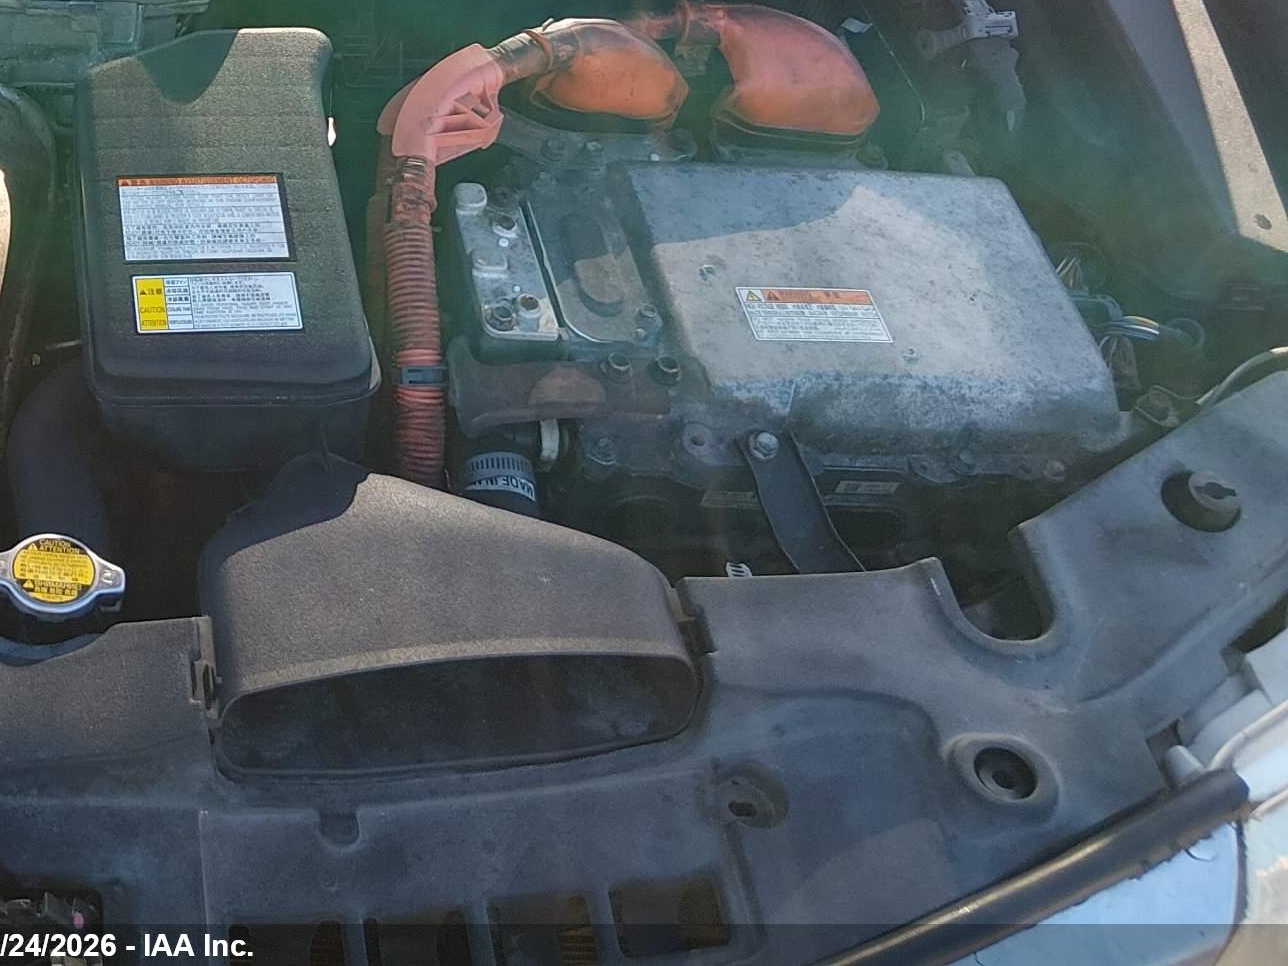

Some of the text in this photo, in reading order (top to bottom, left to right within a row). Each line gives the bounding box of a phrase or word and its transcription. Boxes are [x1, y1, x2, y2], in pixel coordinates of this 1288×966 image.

[502, 475, 534, 498] MADE
[40, 538, 71, 548] CAUTION
[39, 545, 80, 554] ATTENTION
